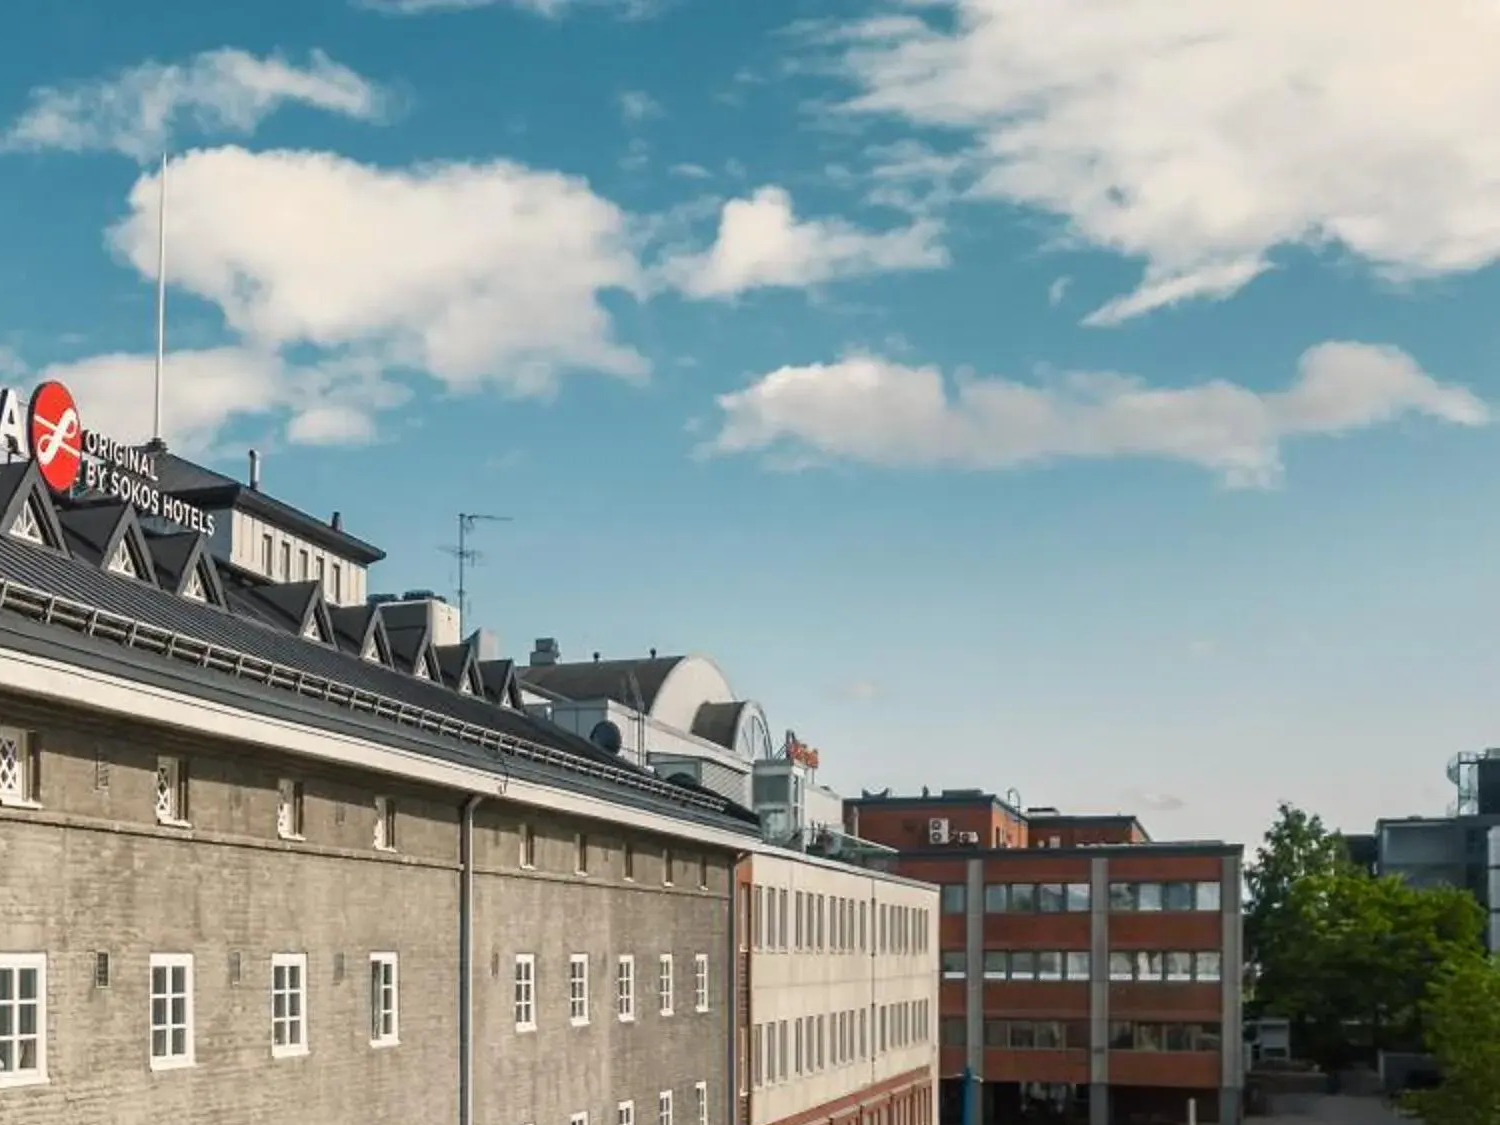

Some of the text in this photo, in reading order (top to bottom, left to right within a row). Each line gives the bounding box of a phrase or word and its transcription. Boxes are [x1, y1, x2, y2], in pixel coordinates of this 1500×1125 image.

[85, 430, 159, 482] ORIGINAL
[86, 460, 216, 537] BY SOKOS HOTELS
